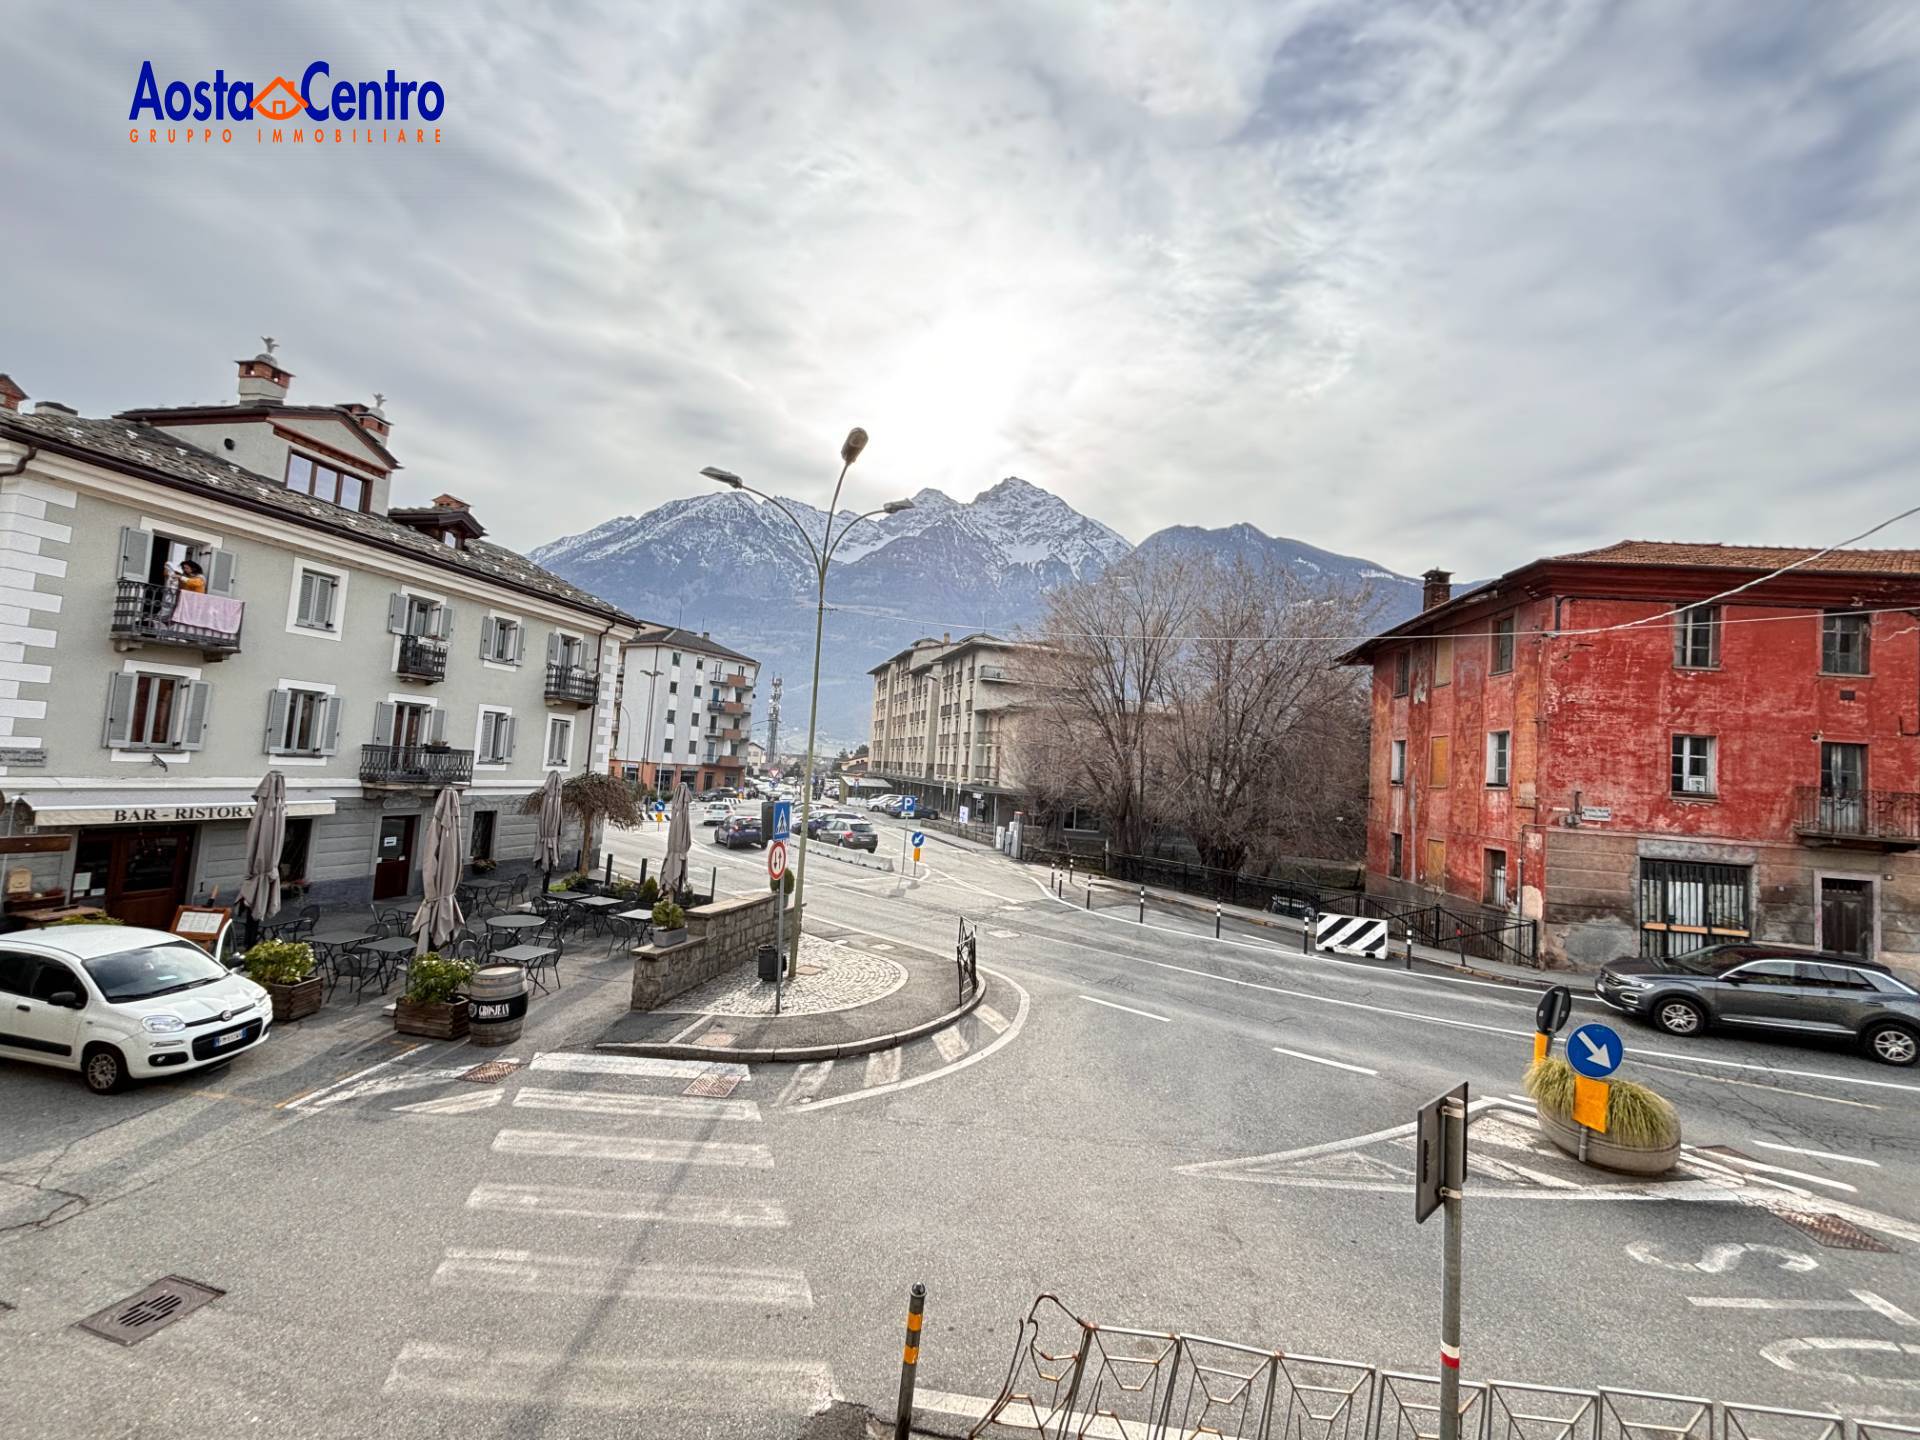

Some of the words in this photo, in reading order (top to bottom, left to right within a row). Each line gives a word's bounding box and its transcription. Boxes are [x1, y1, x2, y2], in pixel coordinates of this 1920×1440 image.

[904, 797, 913, 810] P
[114, 809, 157, 822] BAR
[175, 806, 255, 820] RISTORA
